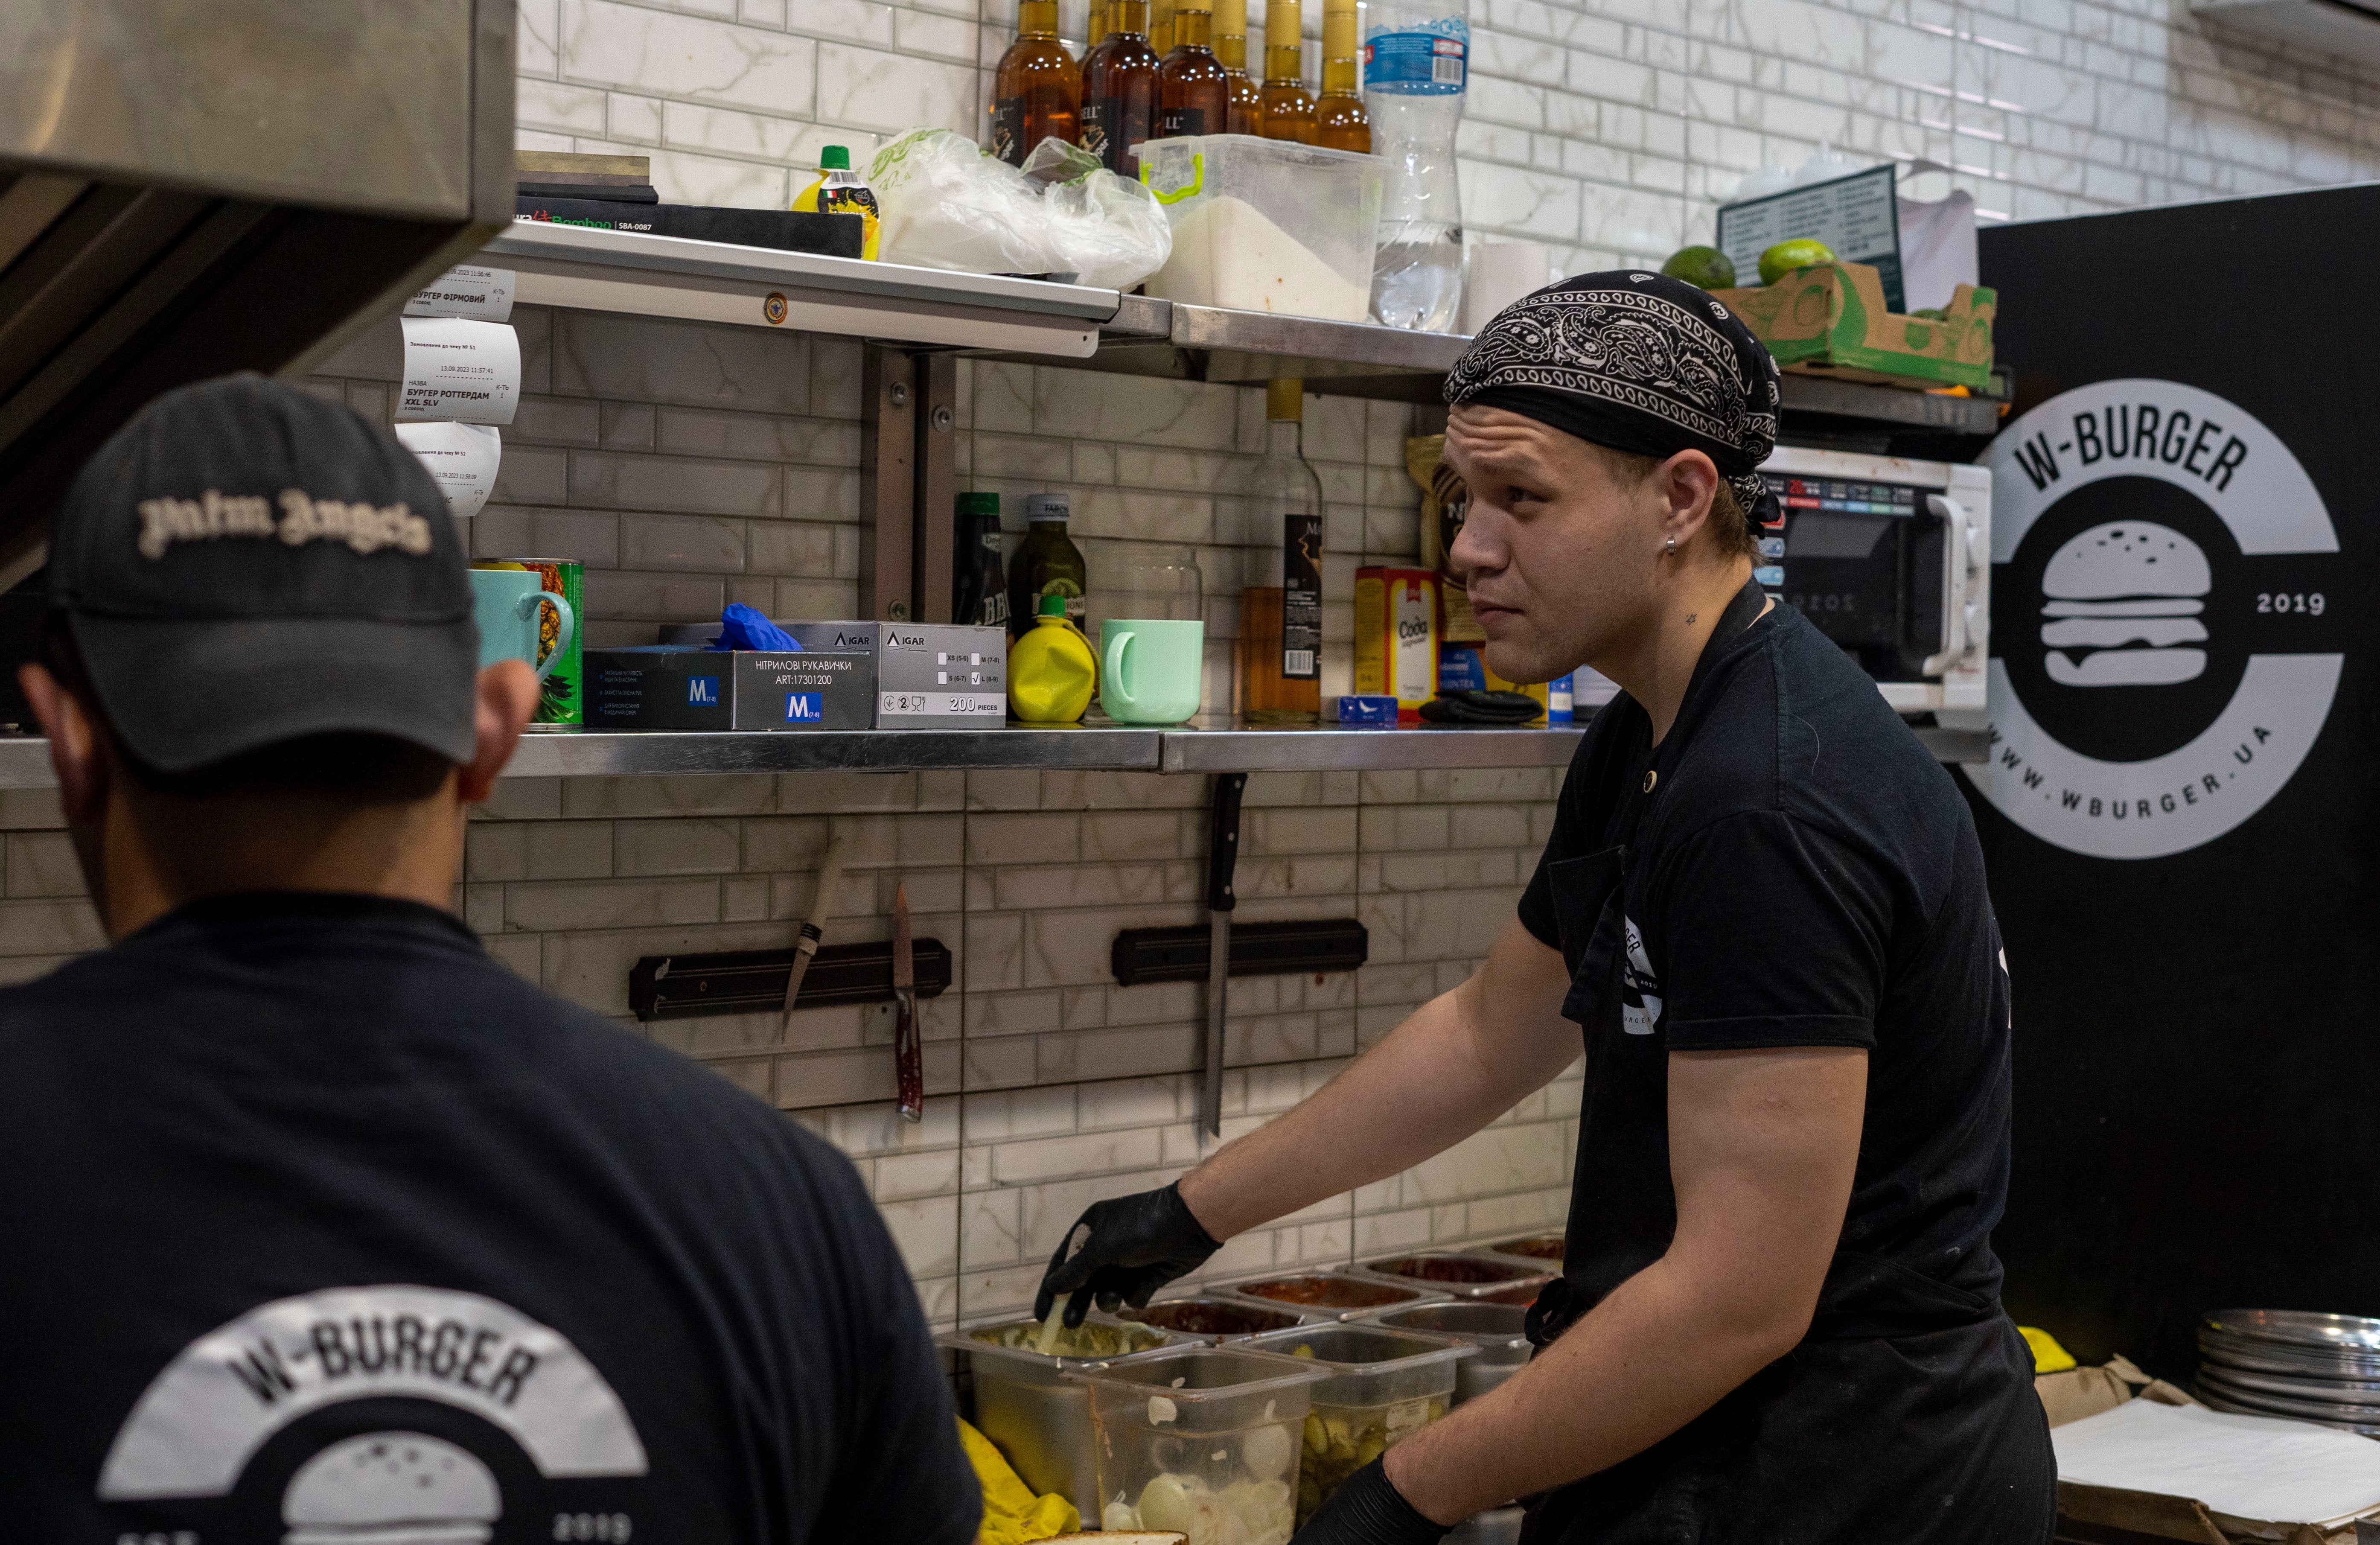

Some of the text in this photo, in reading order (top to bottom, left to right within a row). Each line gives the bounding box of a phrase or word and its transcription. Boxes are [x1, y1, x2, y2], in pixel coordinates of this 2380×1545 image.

[619, 222, 652, 231] SBA-0087
[443, 293, 485, 303] ФІРМОВИЙ
[407, 388, 438, 397] БУРГЕР
[440, 390, 489, 400] РОТТЕРДАМ
[404, 398, 421, 406] XXL
[2012, 403, 2248, 494] W-BURGER
[2256, 592, 2326, 616] 2019
[848, 637, 870, 645] IGAR
[902, 637, 924, 645] IGAR
[755, 661, 852, 671] НІТРИЛОВІ РУКАВИЧКИ
[775, 675, 832, 685] ART:17301200
[689, 679, 707, 702] M
[788, 696, 808, 718] M
[949, 696, 976, 712] 200
[1987, 722, 2272, 820] WWW.WBURGER.UA
[226, 1314, 542, 1408] W-BURGER
